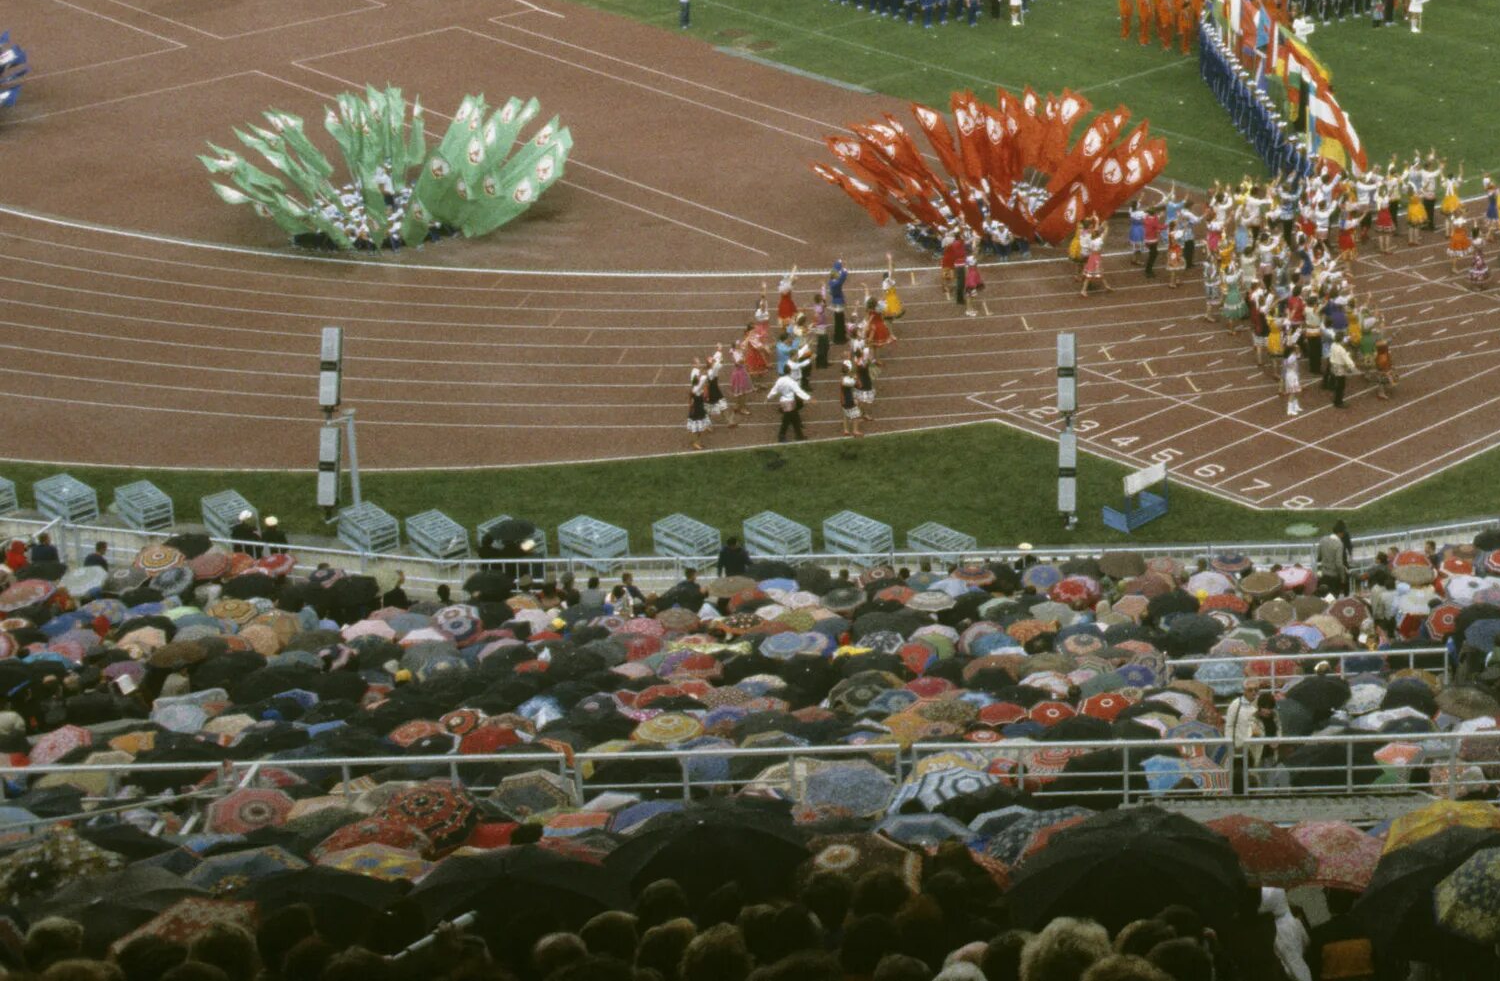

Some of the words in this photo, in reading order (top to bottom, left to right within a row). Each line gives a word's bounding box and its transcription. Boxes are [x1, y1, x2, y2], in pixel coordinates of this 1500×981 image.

[1027, 406, 1059, 419] 2
[1073, 420, 1100, 433] 3
[1111, 435, 1140, 448] 4
[1151, 447, 1184, 464] 5
[1193, 463, 1226, 478] 6
[1240, 478, 1272, 493] 7
[1282, 495, 1314, 511] 8
